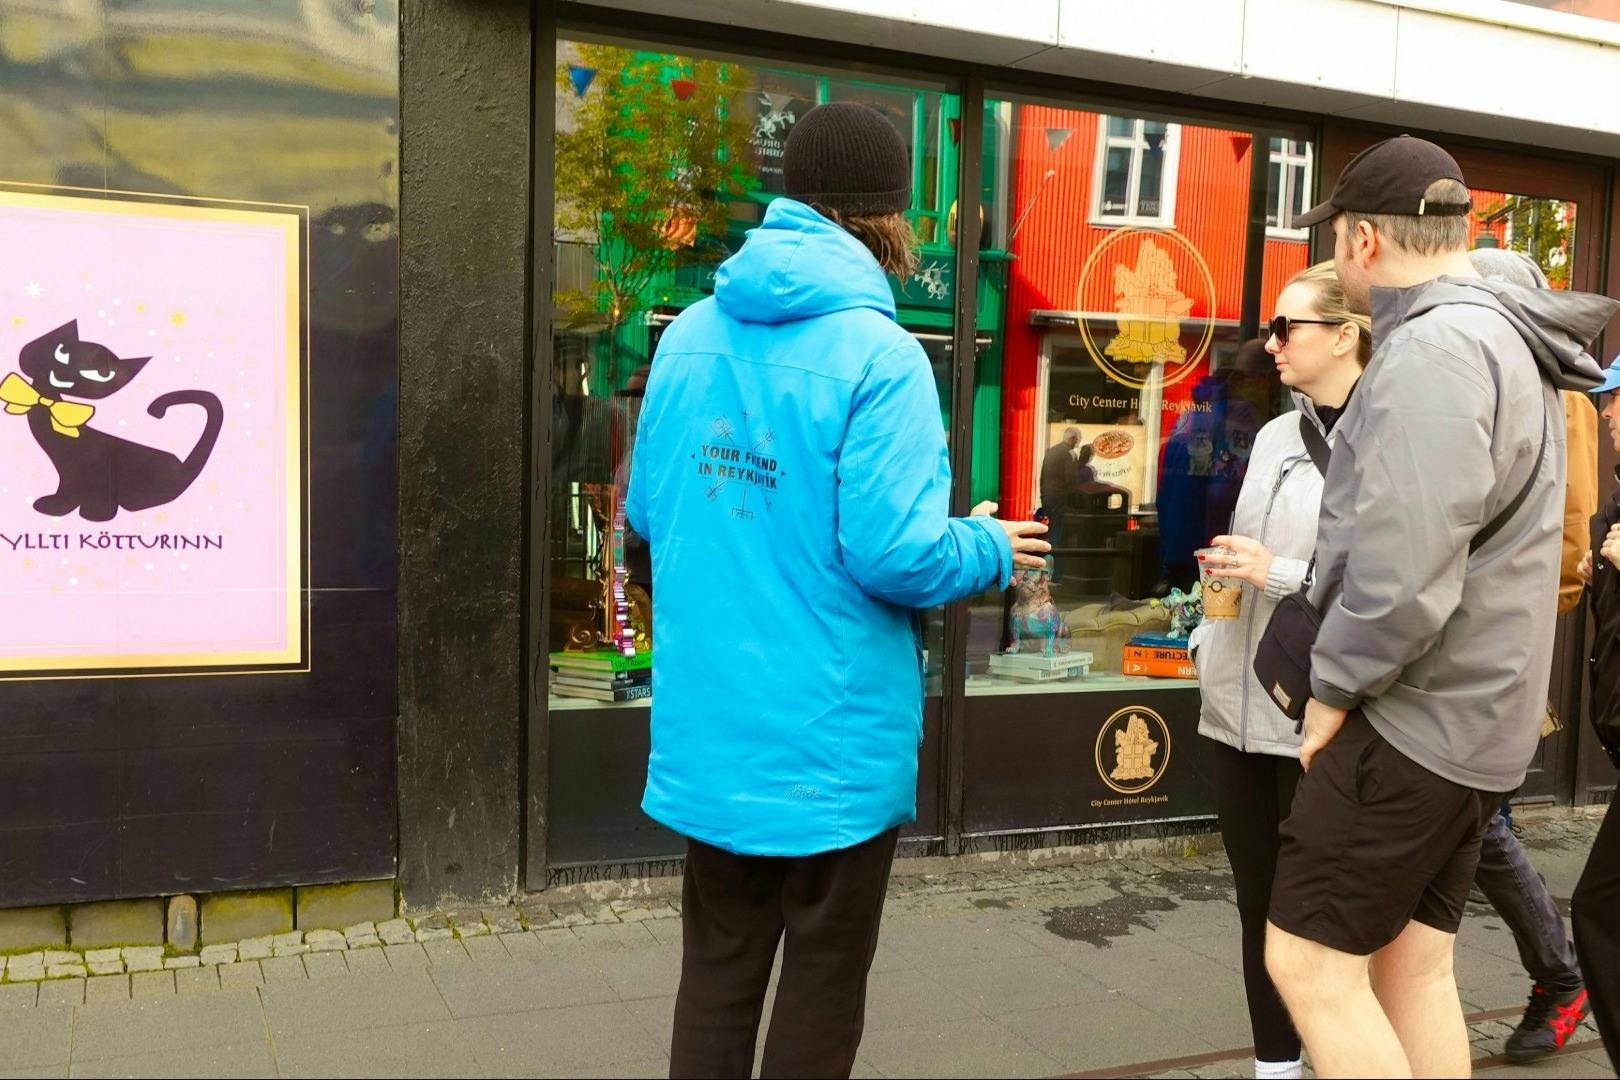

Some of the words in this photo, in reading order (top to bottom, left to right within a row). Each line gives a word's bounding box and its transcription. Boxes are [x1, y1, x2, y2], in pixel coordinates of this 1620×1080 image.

[1069, 394, 1089, 409] City
[1092, 396, 1127, 409] Center
[701, 445, 741, 463] YOUR
[697, 462, 713, 476] IN
[79, 531, 223, 550] KÖTTURINN
[1154, 651, 1190, 660] ECTURE
[630, 687, 651, 699] STARS
[1090, 799, 1102, 807] City
